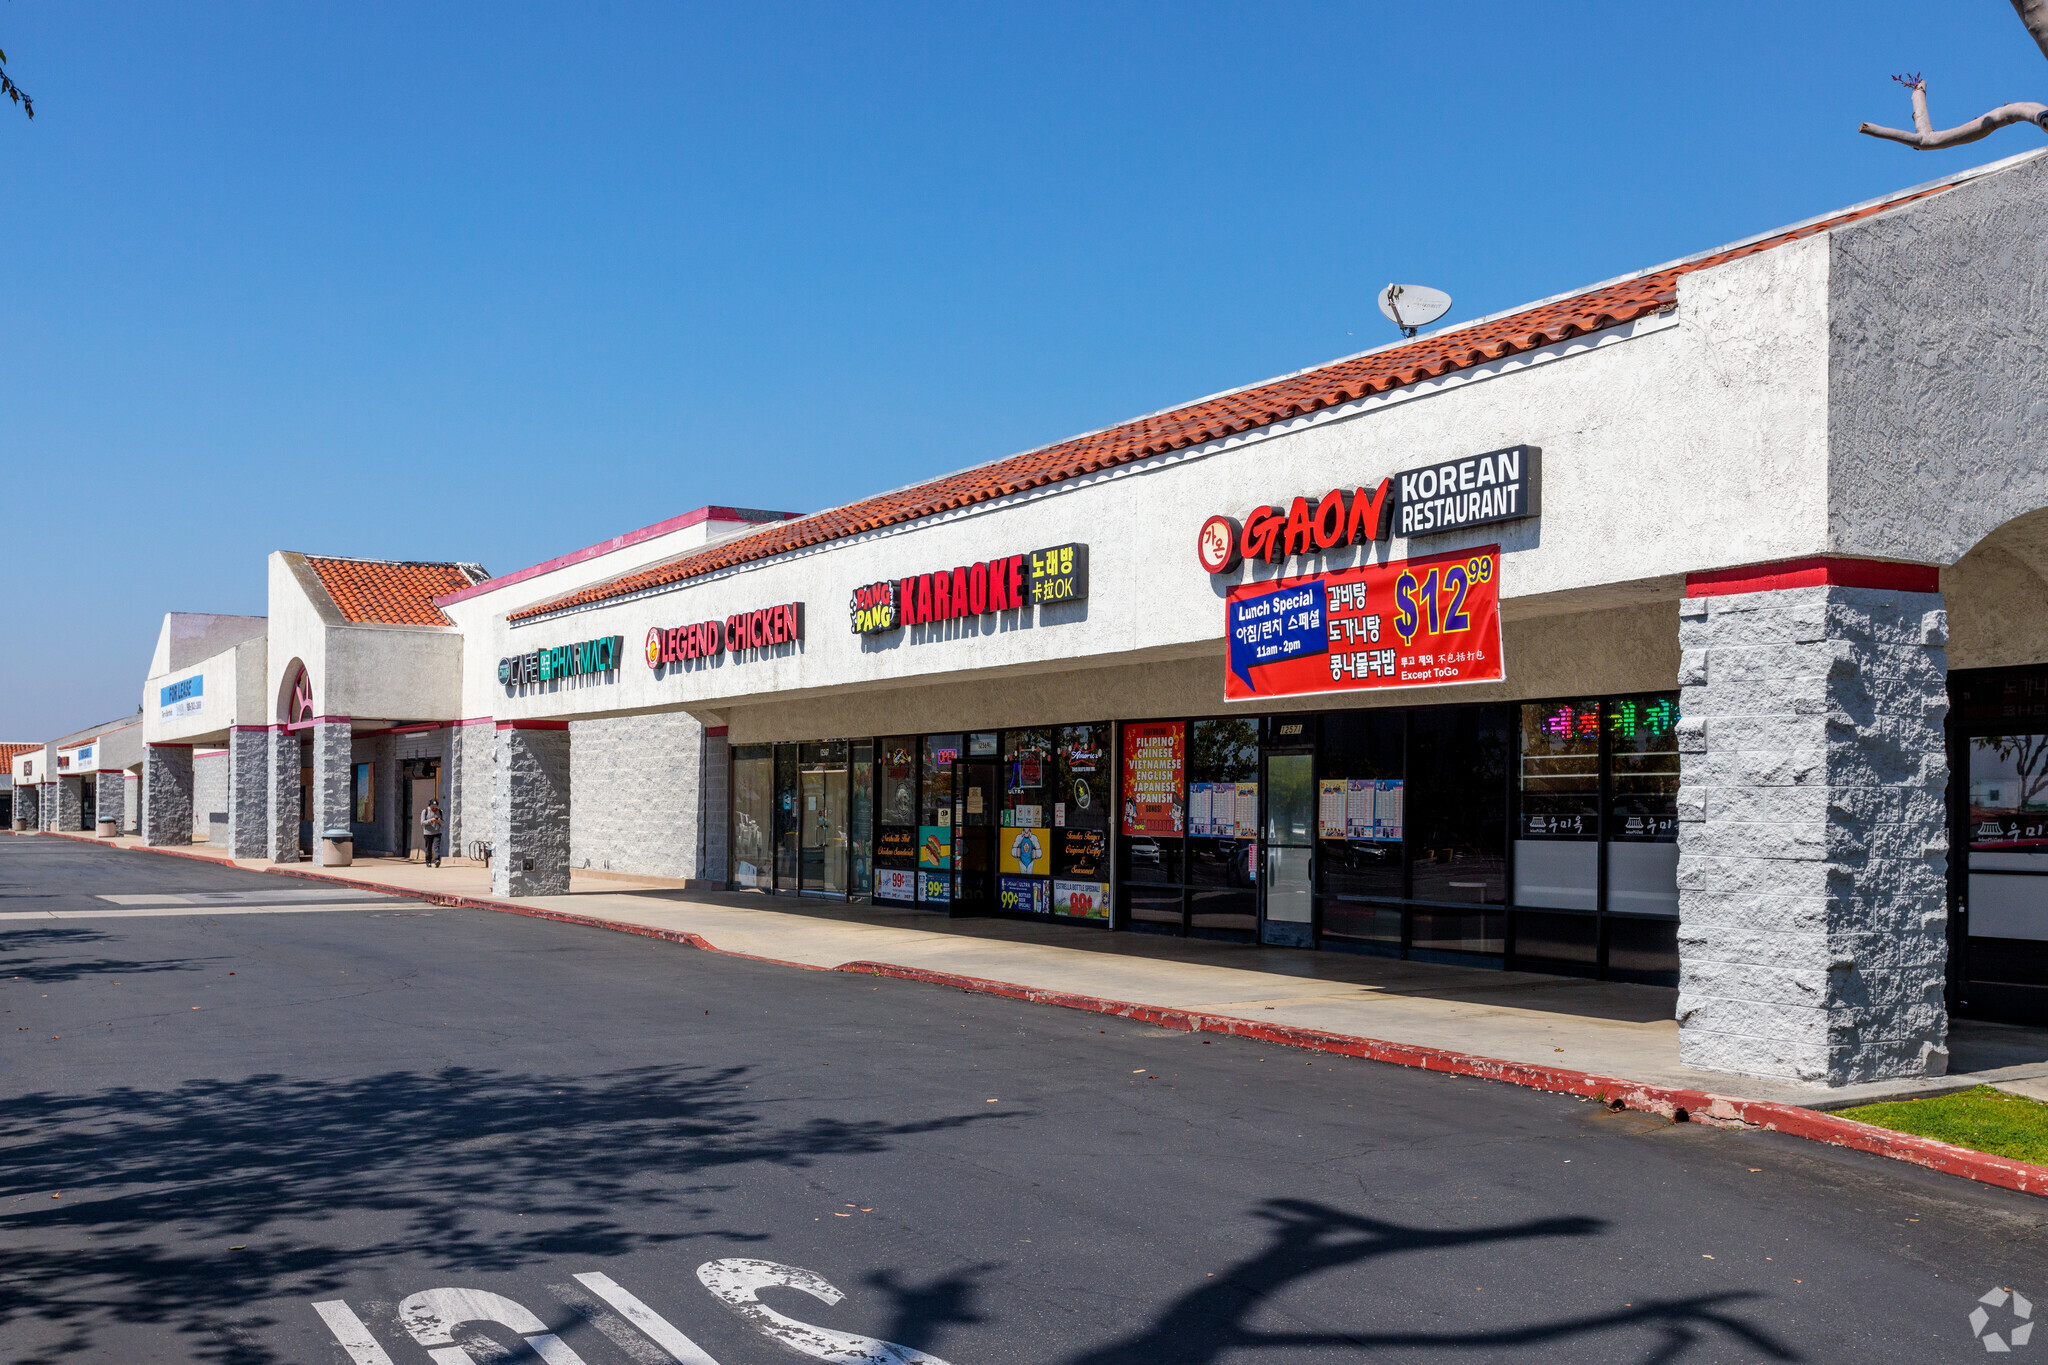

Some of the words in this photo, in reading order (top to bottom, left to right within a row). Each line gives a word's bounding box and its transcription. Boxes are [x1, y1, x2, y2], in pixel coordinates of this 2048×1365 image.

[1401, 450, 1520, 503] KOREAN
[1401, 483, 1520, 533] RESTAURANT
[1241, 477, 1390, 564] GAON
[1204, 524, 1226, 561] 가온
[1032, 546, 1074, 579] 노래방
[856, 582, 892, 610] PANG
[900, 554, 1023, 626] KARAOKE
[1032, 577, 1074, 603] 卡拉OK
[1327, 581, 1367, 612] 갈비탕
[1238, 600, 1270, 622] Lunch
[1272, 589, 1313, 615] Special
[856, 605, 893, 633] PANG
[1236, 617, 1283, 645] 아침/런치
[1287, 608, 1320, 631] 스페셜
[662, 620, 719, 664] LEGEND
[724, 602, 797, 653] CHICKEN
[1328, 613, 1381, 645] 도가니탕
[1256, 644, 1278, 658] 11am
[1283, 639, 1301, 654] 2pm
[511, 652, 539, 686] CAFE
[552, 635, 616, 679] PHARMACY
[1329, 647, 1396, 682] 콩나물국밥
[1400, 656, 1416, 668] 투고
[1418, 654, 1434, 666] 제외
[1437, 649, 1486, 664] 不包括打包
[1401, 669, 1432, 681] Except
[1433, 667, 1459, 678] ToGo
[168, 685, 177, 703] FOR
[178, 680, 192, 700] LEASE
[1143, 727, 1167, 736] FEATURING
[1281, 725, 1301, 734] 12571
[1136, 736, 1175, 748] FILIPINO
[938, 750, 956, 763] OPEN
[1137, 747, 1173, 759] CHINESE
[1128, 758, 1182, 770] VIETNAMESE
[1136, 770, 1173, 781] ENGLISH
[1133, 781, 1176, 792] JAPANESE
[1135, 792, 1173, 804] SPANISH
[1548, 815, 1584, 835] 우미옥
[1646, 816, 1678, 835] 우미
[1066, 830, 1083, 840] Tender
[877, 846, 893, 855] Chicken
[894, 846, 914, 856] Sandwich
[1065, 844, 1087, 856] Original
[1086, 844, 1102, 857] Crispy
[1070, 864, 1096, 875] Seasoned
[1080, 856, 1087, 867] &
[927, 880, 943, 897] 99¢
[1055, 882, 1072, 891] ESTRELLA
[1072, 883, 1085, 892] BOTTLE
[1085, 884, 1101, 893] SPECIAL!
[1001, 891, 1019, 909] 99¢
[1070, 892, 1093, 917] 99¢
